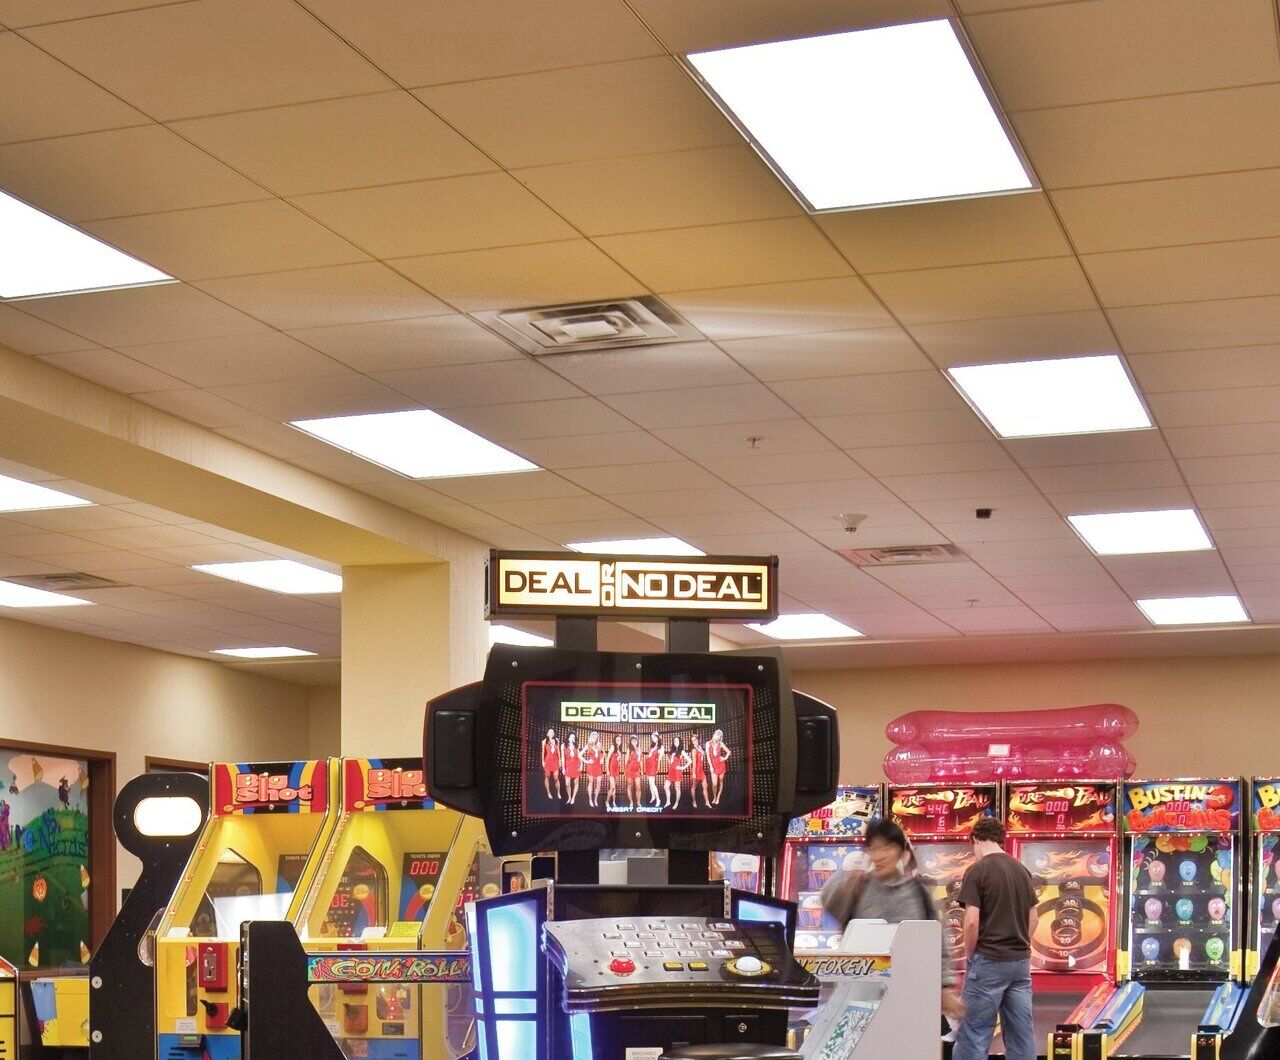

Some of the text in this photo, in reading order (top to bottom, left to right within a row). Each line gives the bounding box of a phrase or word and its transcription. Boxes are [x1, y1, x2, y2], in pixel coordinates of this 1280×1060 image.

[504, 562, 762, 608] DEAL OR NO DEAL
[565, 706, 618, 717] DEAL
[633, 706, 661, 719] NO
[664, 706, 712, 719] DEAL
[235, 771, 289, 789] Big
[367, 766, 423, 785] Big
[236, 784, 313, 802] Shot
[892, 789, 926, 812] FIRE
[1010, 785, 1045, 808] FIRE
[1128, 783, 1214, 811] BUSTIN'
[1045, 801, 1069, 812] 000
[1165, 801, 1191, 813] 000
[938, 816, 946, 827] 6
[1057, 814, 1065, 825] 0
[409, 861, 440, 875] 000
[330, 959, 400, 978] COIN
[813, 956, 876, 976] TOKEN
